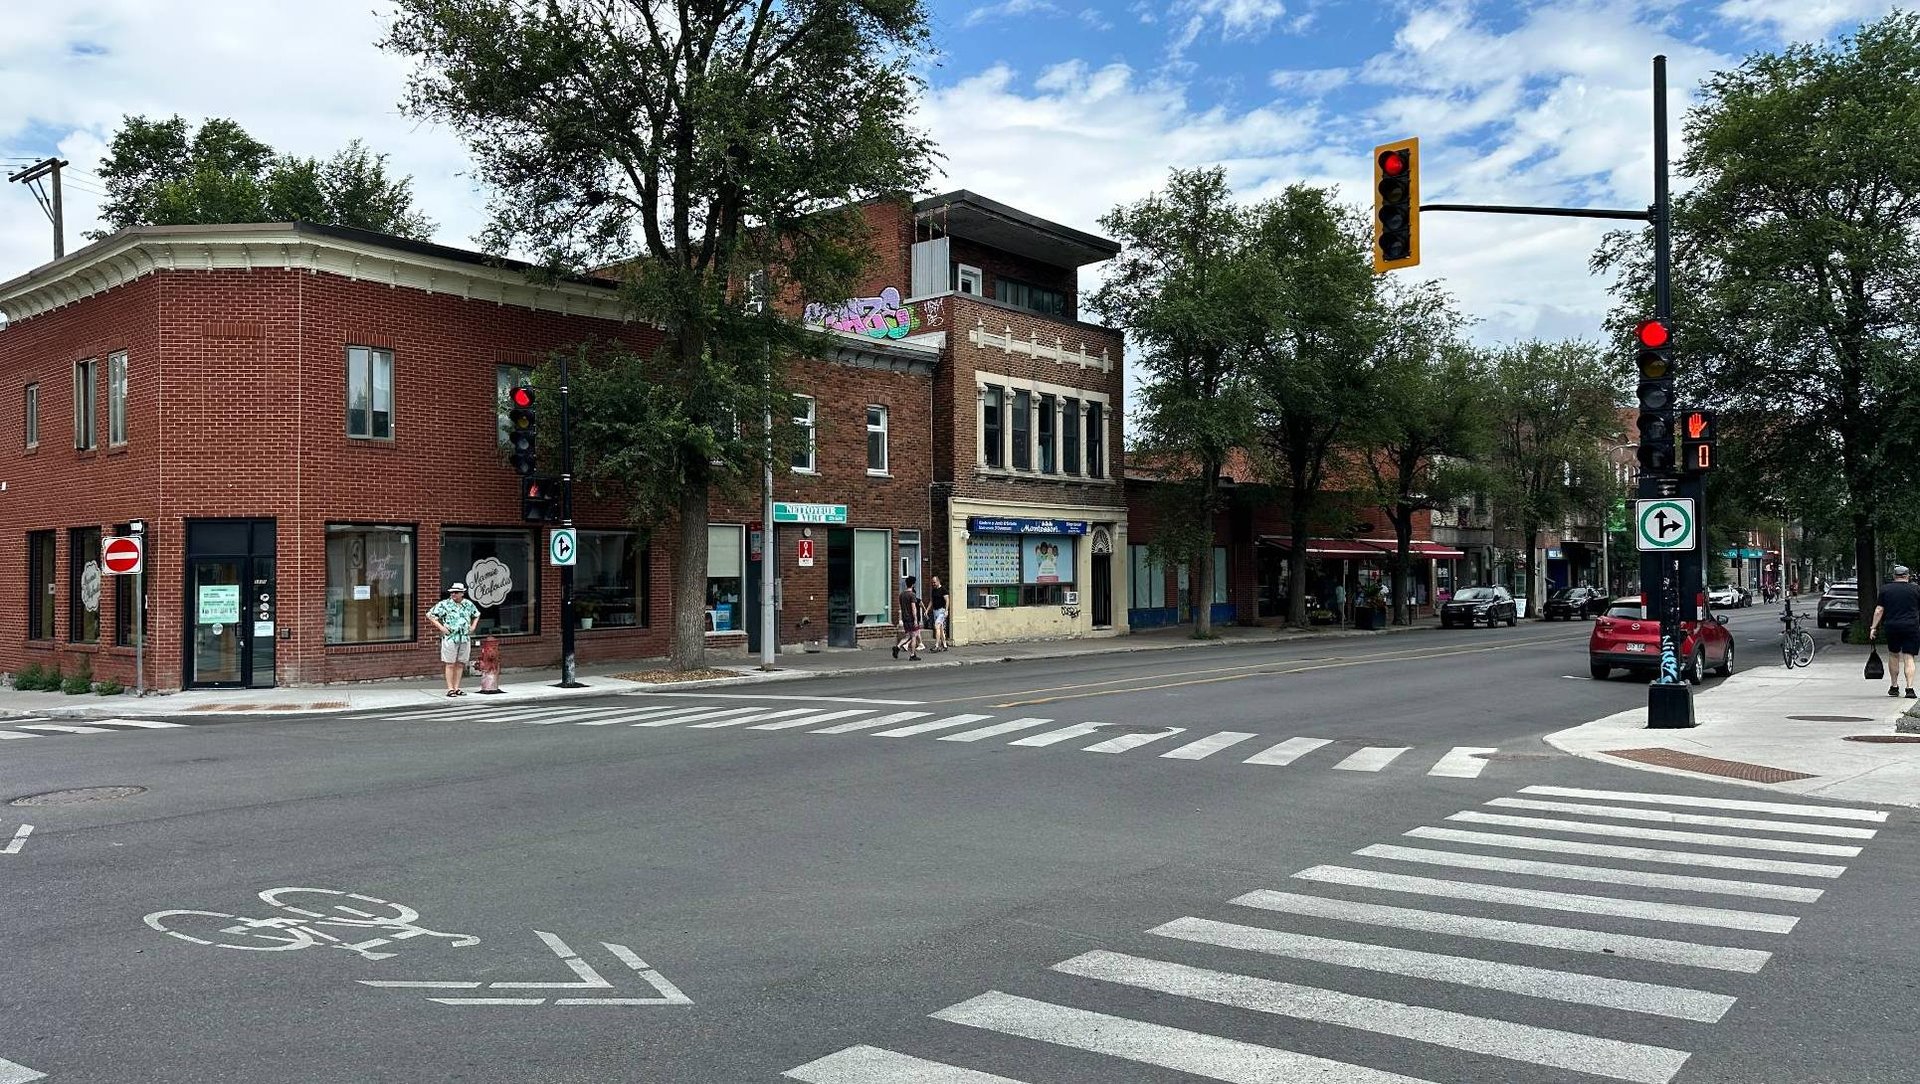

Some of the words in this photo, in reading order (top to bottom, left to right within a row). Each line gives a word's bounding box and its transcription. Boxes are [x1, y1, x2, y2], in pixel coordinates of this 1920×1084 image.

[786, 505, 836, 515] NETTOYEUR
[469, 568, 498, 590] Mamie
[474, 577, 510, 600] Clafoutis
